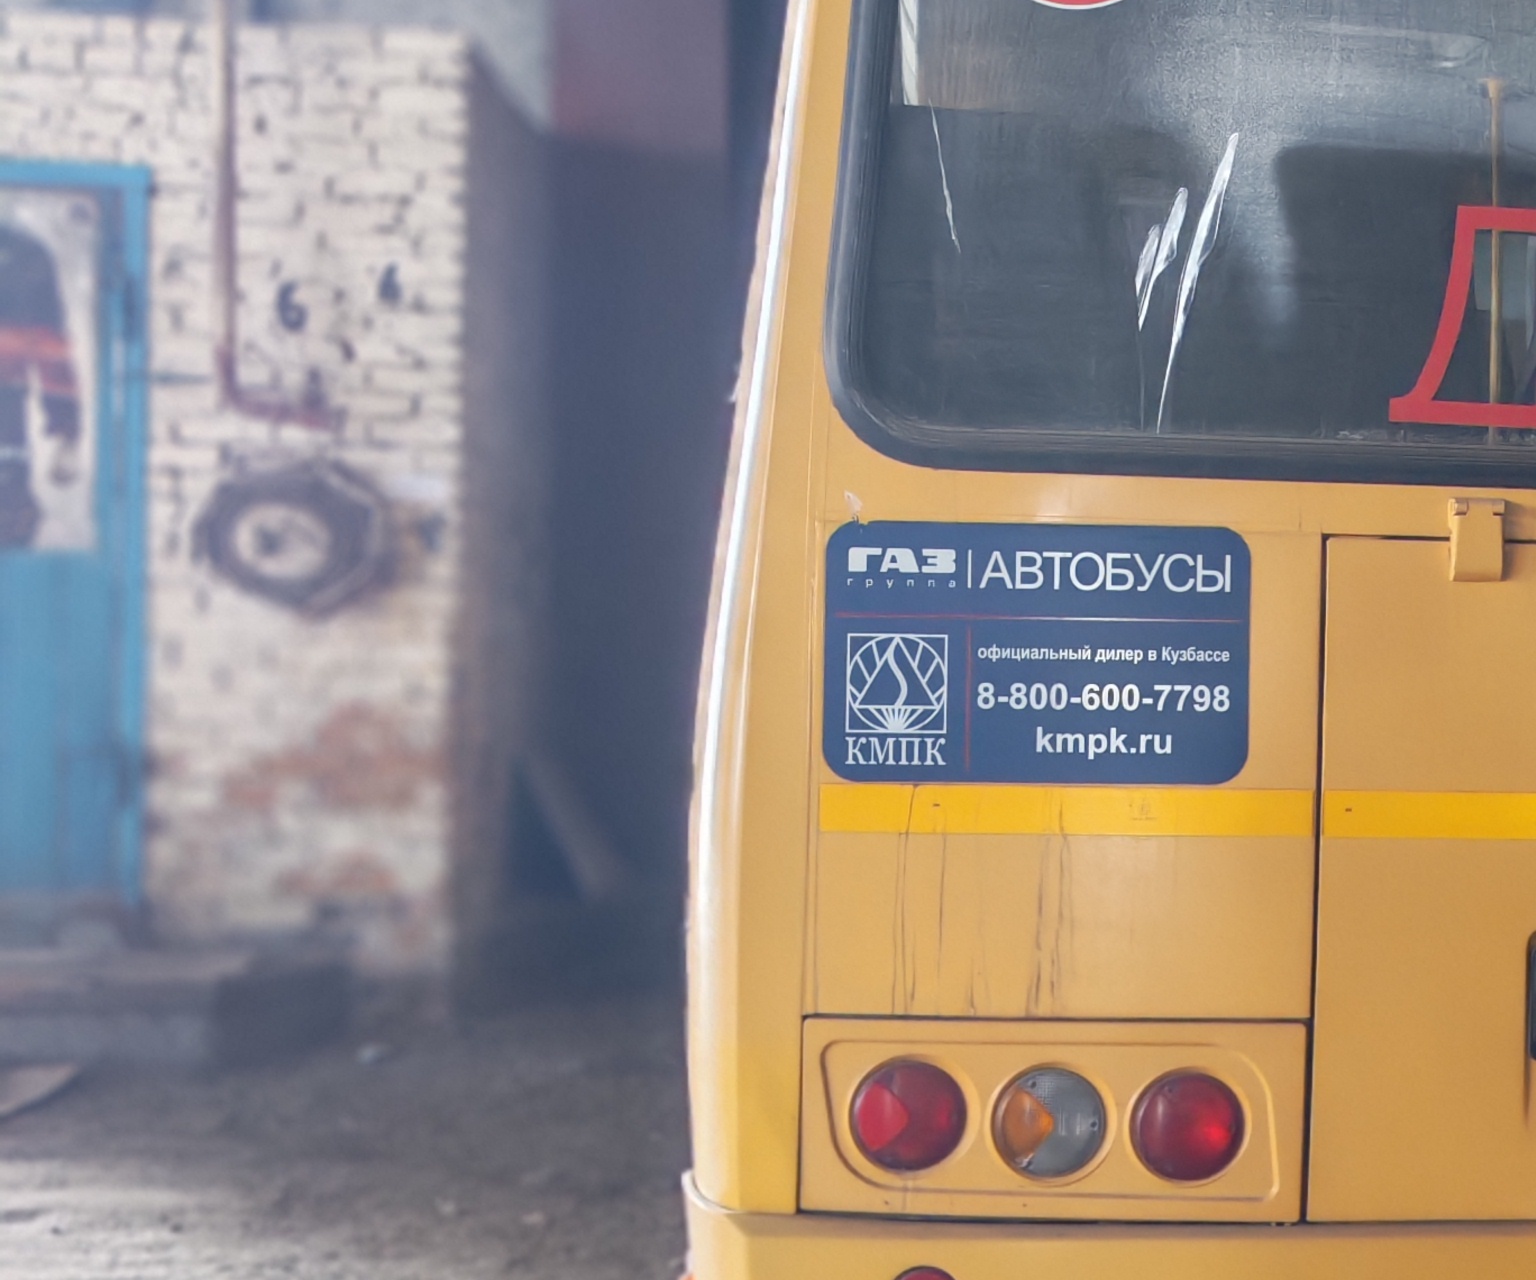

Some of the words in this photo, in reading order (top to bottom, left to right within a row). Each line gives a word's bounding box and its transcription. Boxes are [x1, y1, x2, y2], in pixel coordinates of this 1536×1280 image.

[846, 578, 956, 589] группа
[848, 547, 956, 573] ГАЗ
[979, 551, 1232, 592] АВТОБУСЫ
[977, 644, 1091, 662] официальный
[1094, 648, 1144, 664] дилер
[1148, 649, 1157, 661] в
[1161, 646, 1231, 665] Кузбассе
[977, 682, 1231, 712] 8-800-600-7798
[845, 736, 946, 766] КМПК
[1035, 726, 1173, 760] kmpk.ru
